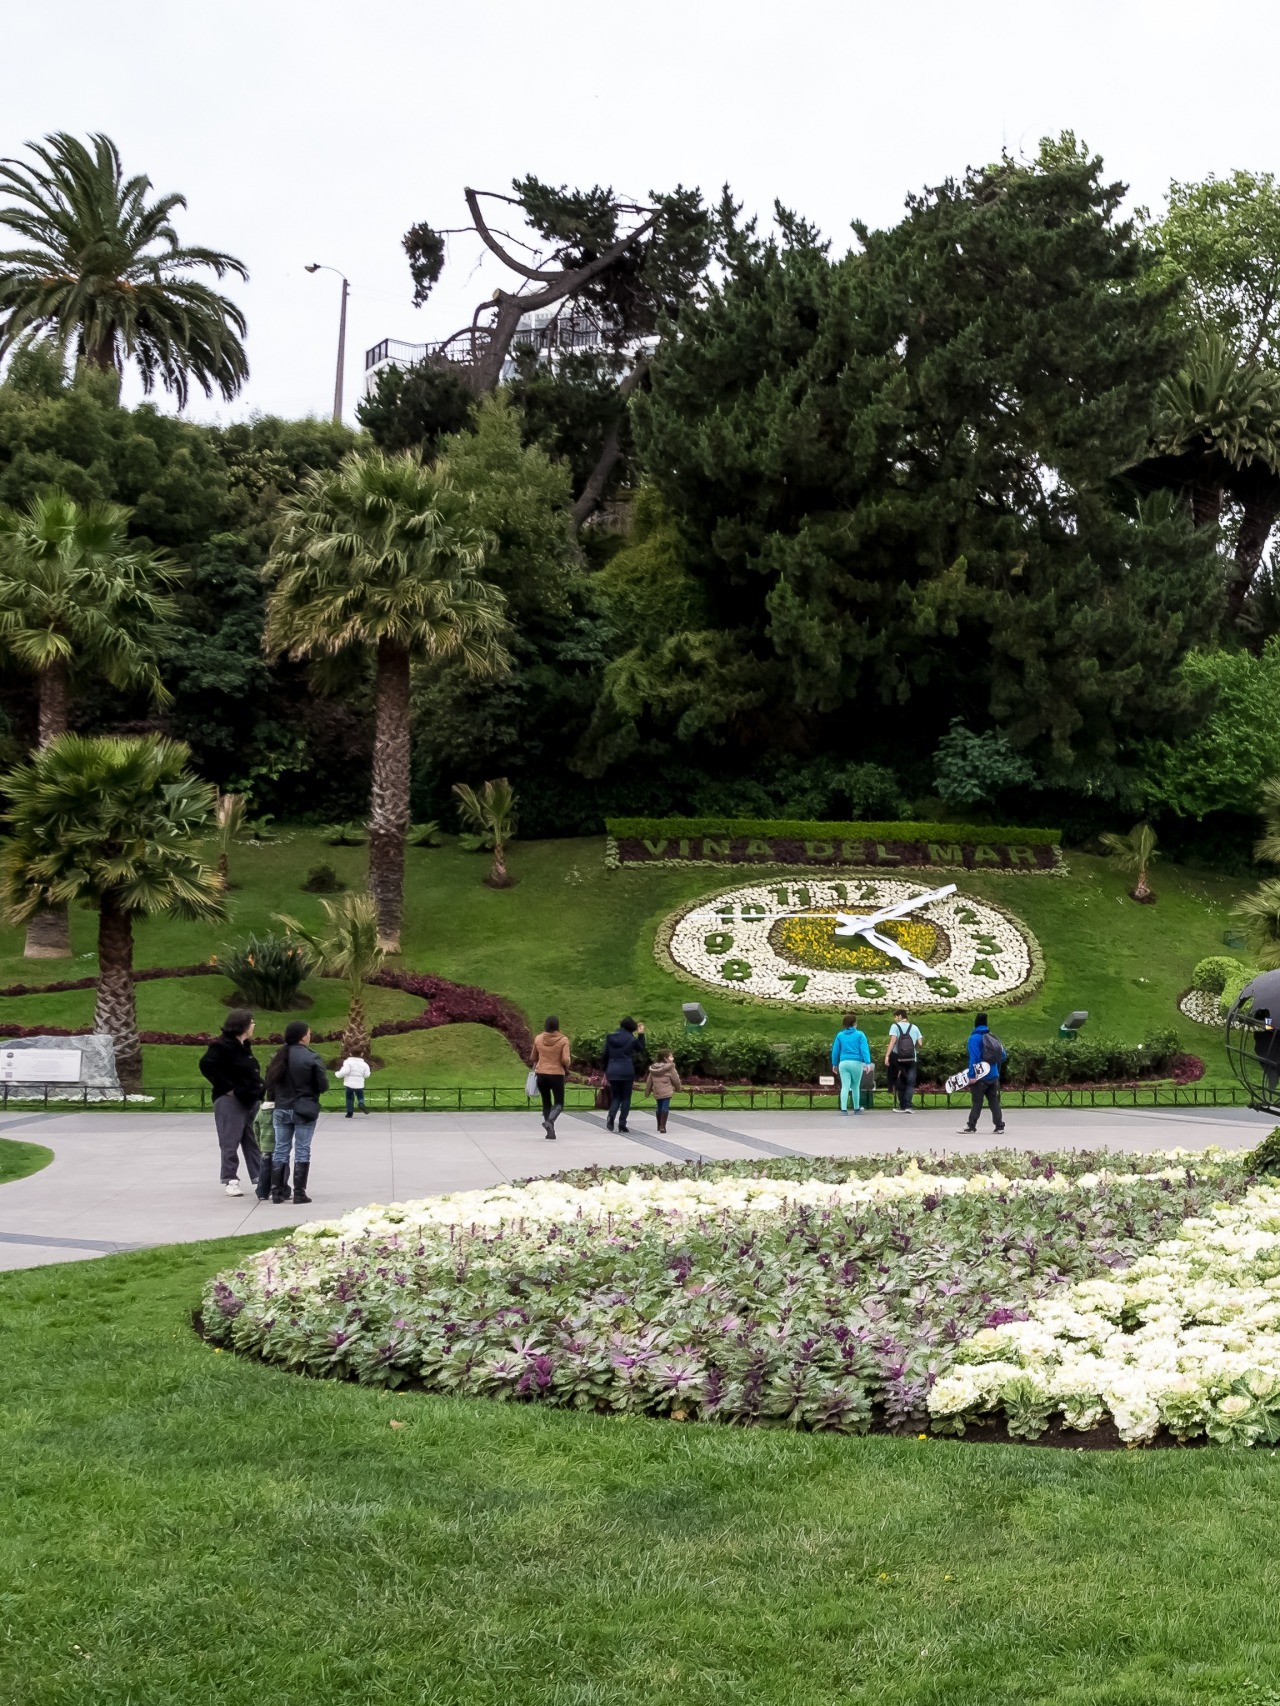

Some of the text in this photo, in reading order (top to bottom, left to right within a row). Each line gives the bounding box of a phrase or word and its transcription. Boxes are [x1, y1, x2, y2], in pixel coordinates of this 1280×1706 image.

[803, 841, 901, 860] DEL
[927, 843, 1038, 864] MAR
[768, 887, 811, 906] 11
[827, 883, 880, 900] 12
[715, 904, 766, 924] 10
[953, 906, 982, 924] 2
[704, 932, 734, 955] 9
[972, 934, 1003, 955] 3
[721, 959, 752, 982] 8
[969, 957, 1000, 980] 4
[778, 973, 809, 994] 7
[854, 978, 887, 999] 6
[926, 976, 959, 998] 5
